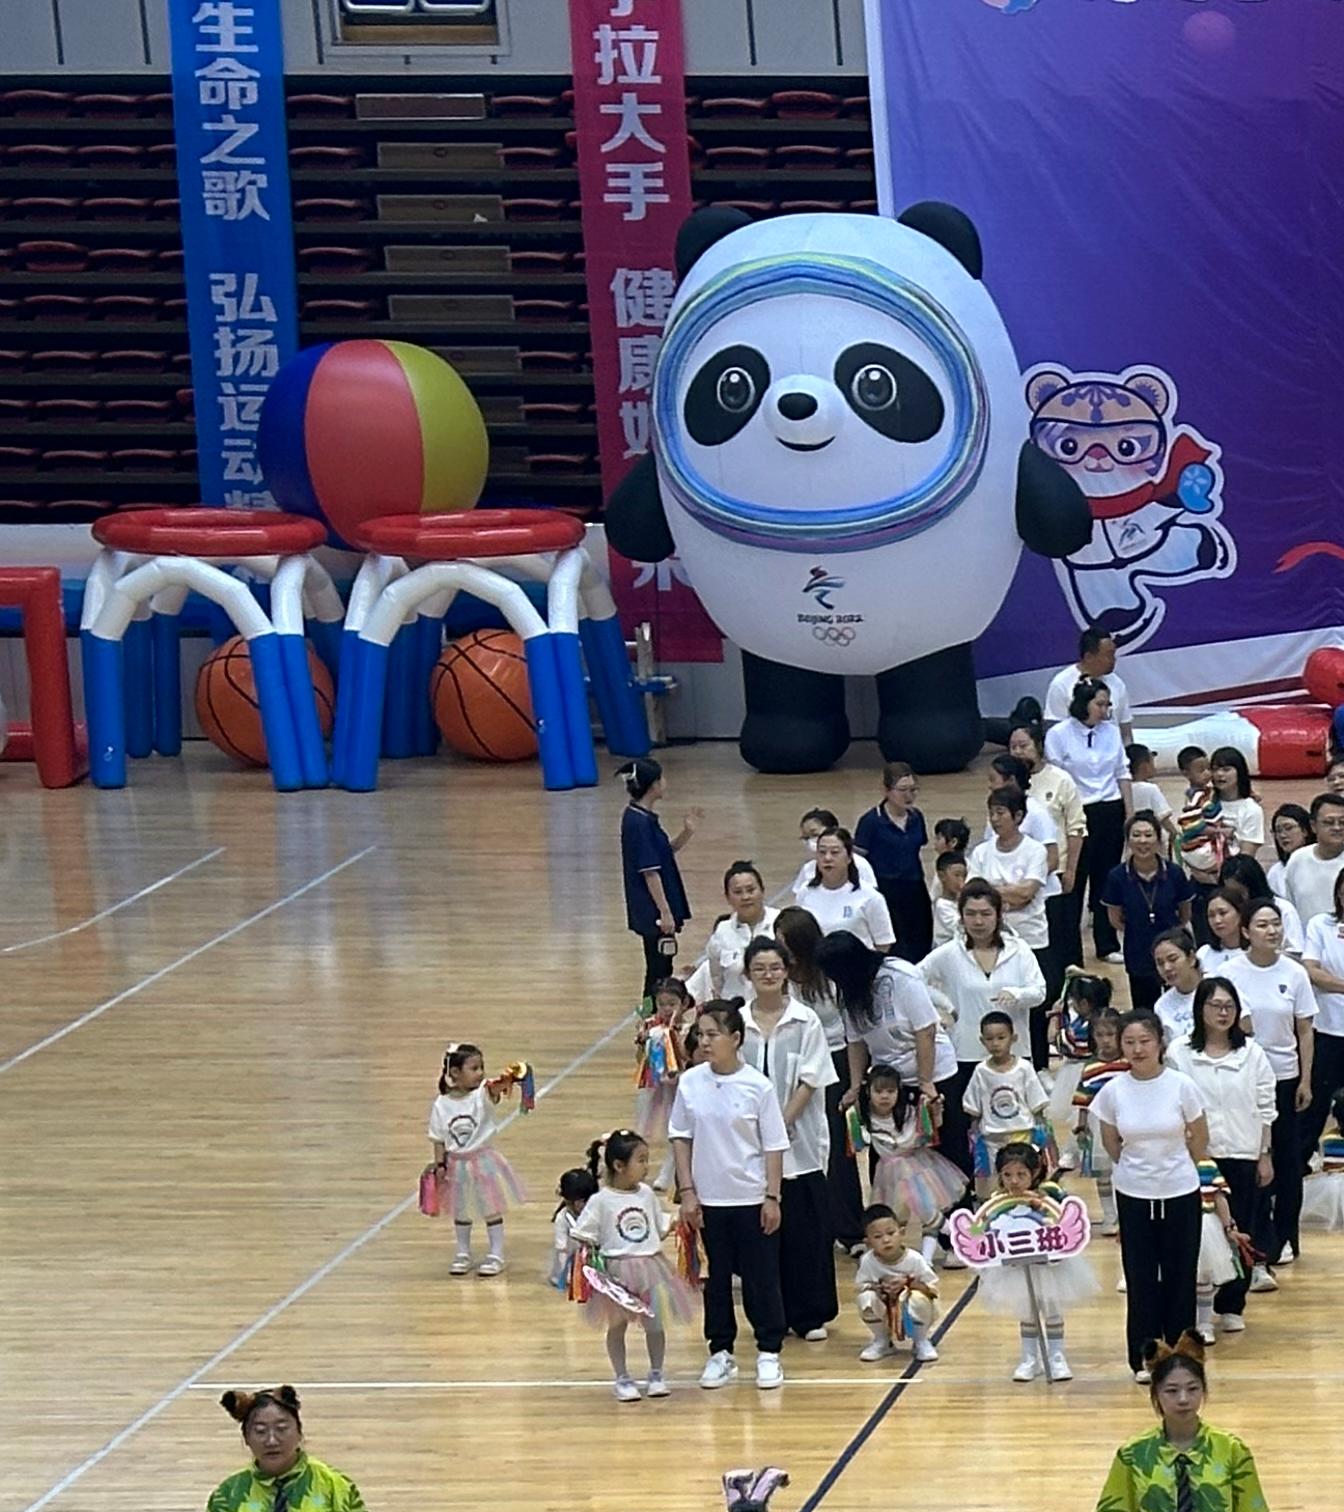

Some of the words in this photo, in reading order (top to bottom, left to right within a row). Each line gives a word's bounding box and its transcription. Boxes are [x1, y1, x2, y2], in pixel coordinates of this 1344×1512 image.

[192, 2, 270, 220] 生命之歌
[593, 0, 670, 221] 拉大手
[977, 1226, 1068, 1259] 小三班
